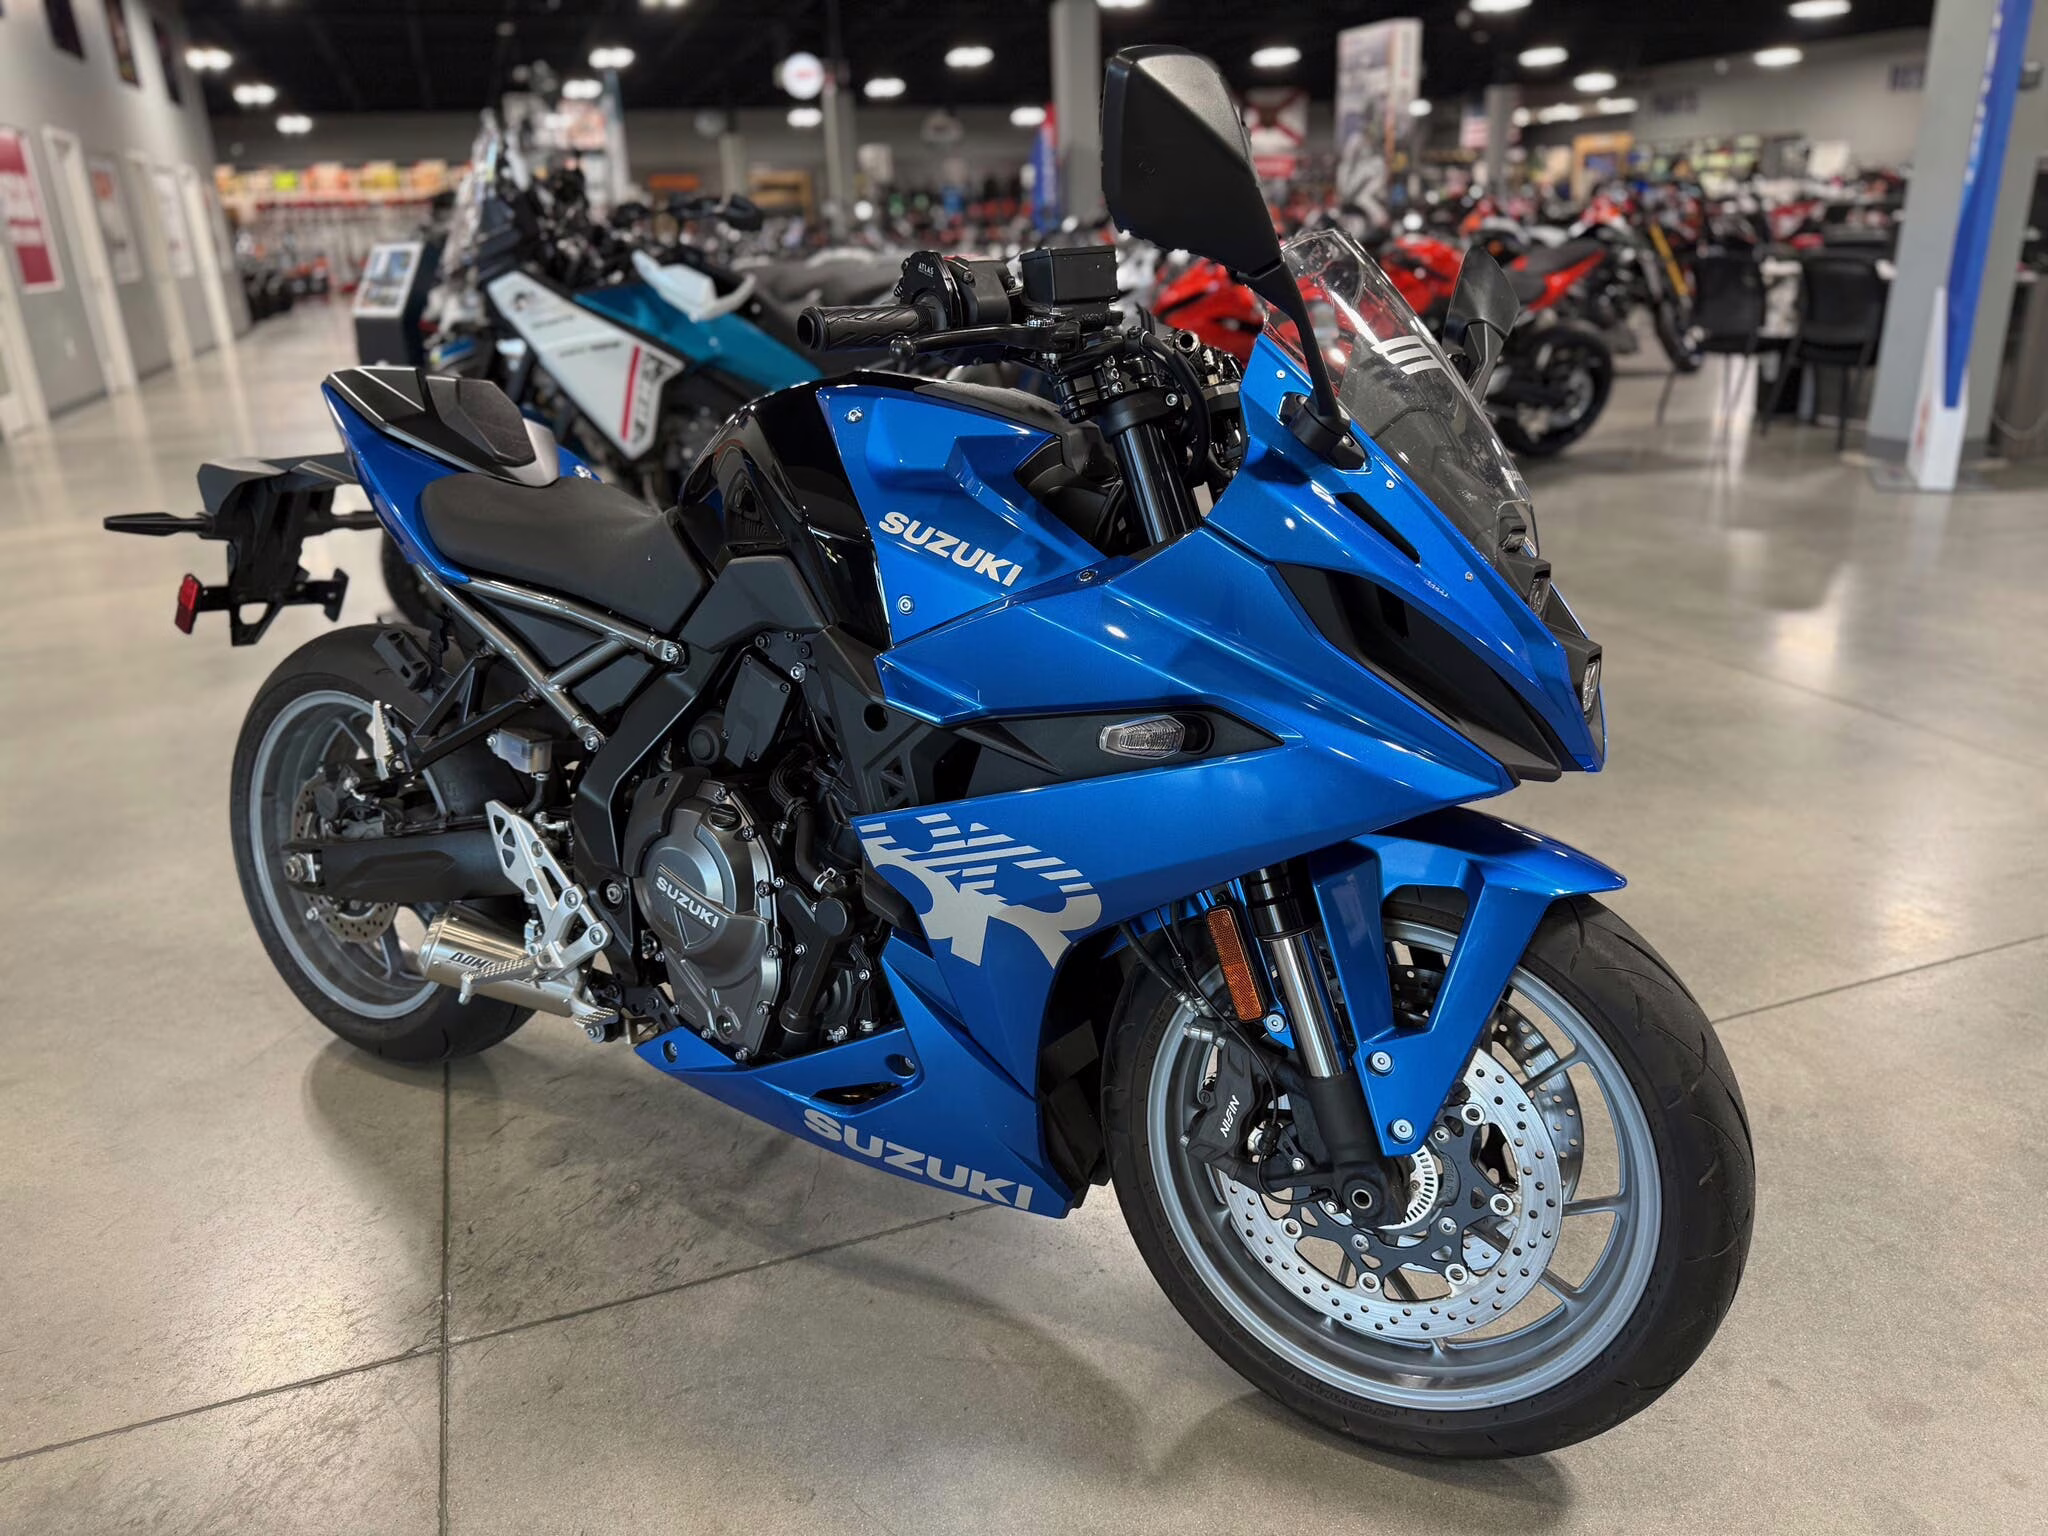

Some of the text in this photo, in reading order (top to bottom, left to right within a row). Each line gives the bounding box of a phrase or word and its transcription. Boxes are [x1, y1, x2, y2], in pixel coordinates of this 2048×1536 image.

[878, 511, 1023, 587] SUZUKI
[656, 876, 720, 929] SUZUKI
[803, 1108, 1034, 1211] SUZUKI
